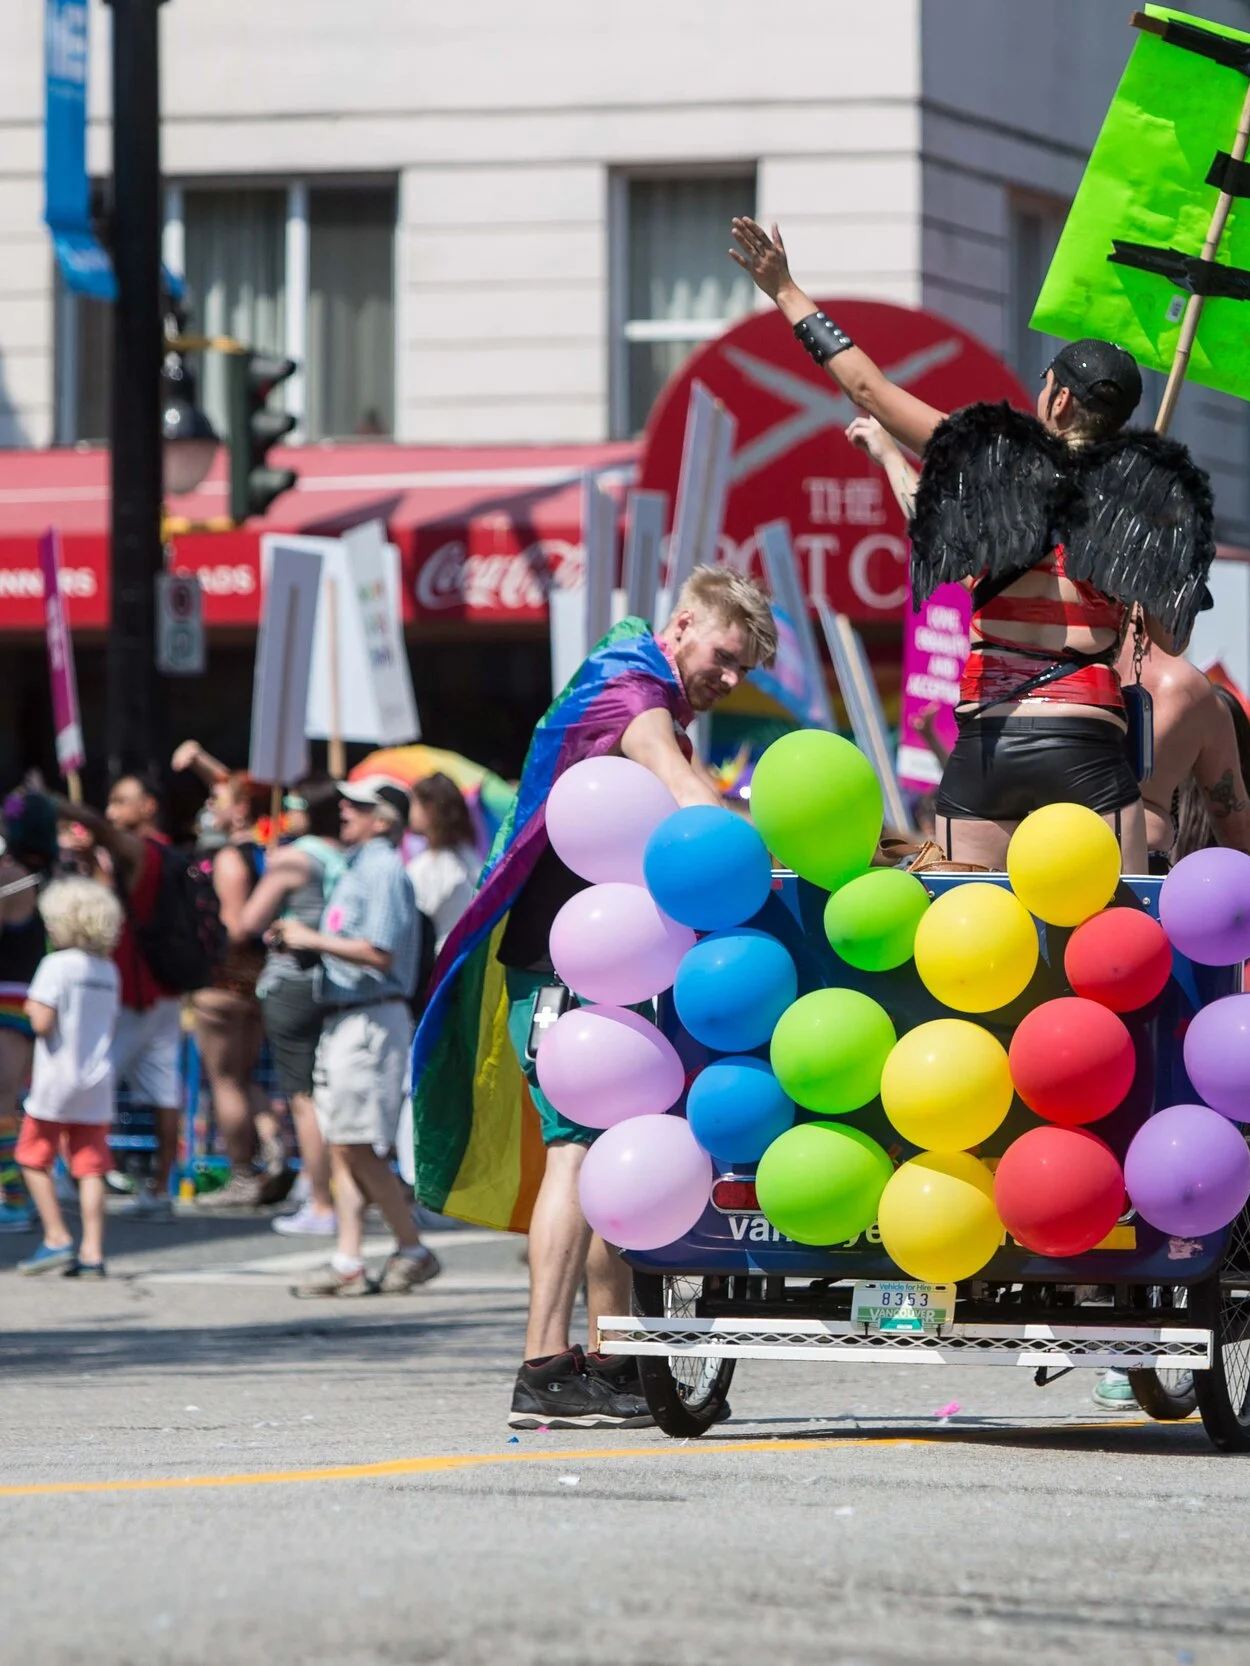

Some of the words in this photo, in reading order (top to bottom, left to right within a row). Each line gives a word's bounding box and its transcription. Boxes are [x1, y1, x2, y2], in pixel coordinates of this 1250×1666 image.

[803, 477, 886, 525] THE
[880, 1282, 904, 1291] Vehicle
[905, 1282, 916, 1291] for
[917, 1283, 932, 1292] Hire
[882, 1292, 929, 1307] 8353
[869, 1308, 936, 1322] VANCOUVER
